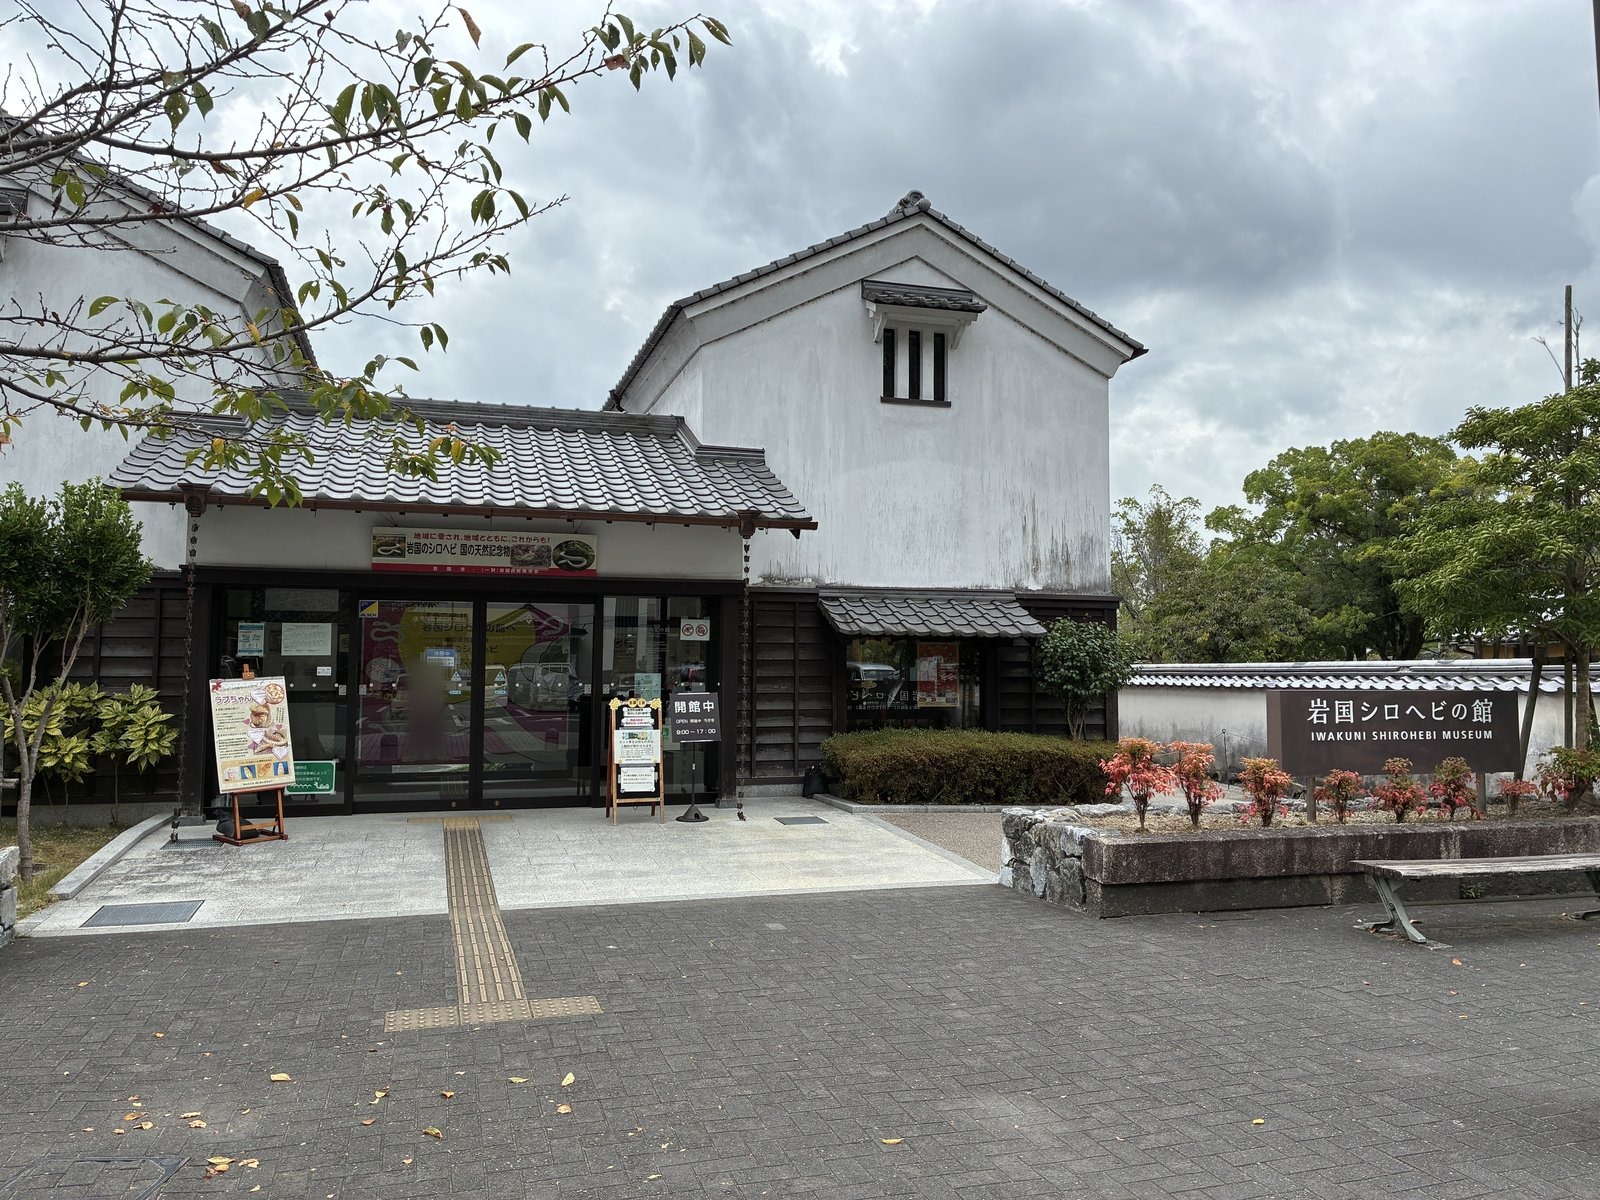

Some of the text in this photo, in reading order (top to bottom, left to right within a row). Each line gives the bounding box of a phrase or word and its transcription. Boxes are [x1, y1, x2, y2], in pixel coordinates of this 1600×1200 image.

[406, 541, 511, 558] 岩国のシロヘビ 国の天然記念物
[674, 700, 715, 714] 開館中
[1307, 698, 1494, 725] 岩国シロヘビの館
[1311, 730, 1494, 742] IWAKUNI SHIROHEBI MUSEUM
